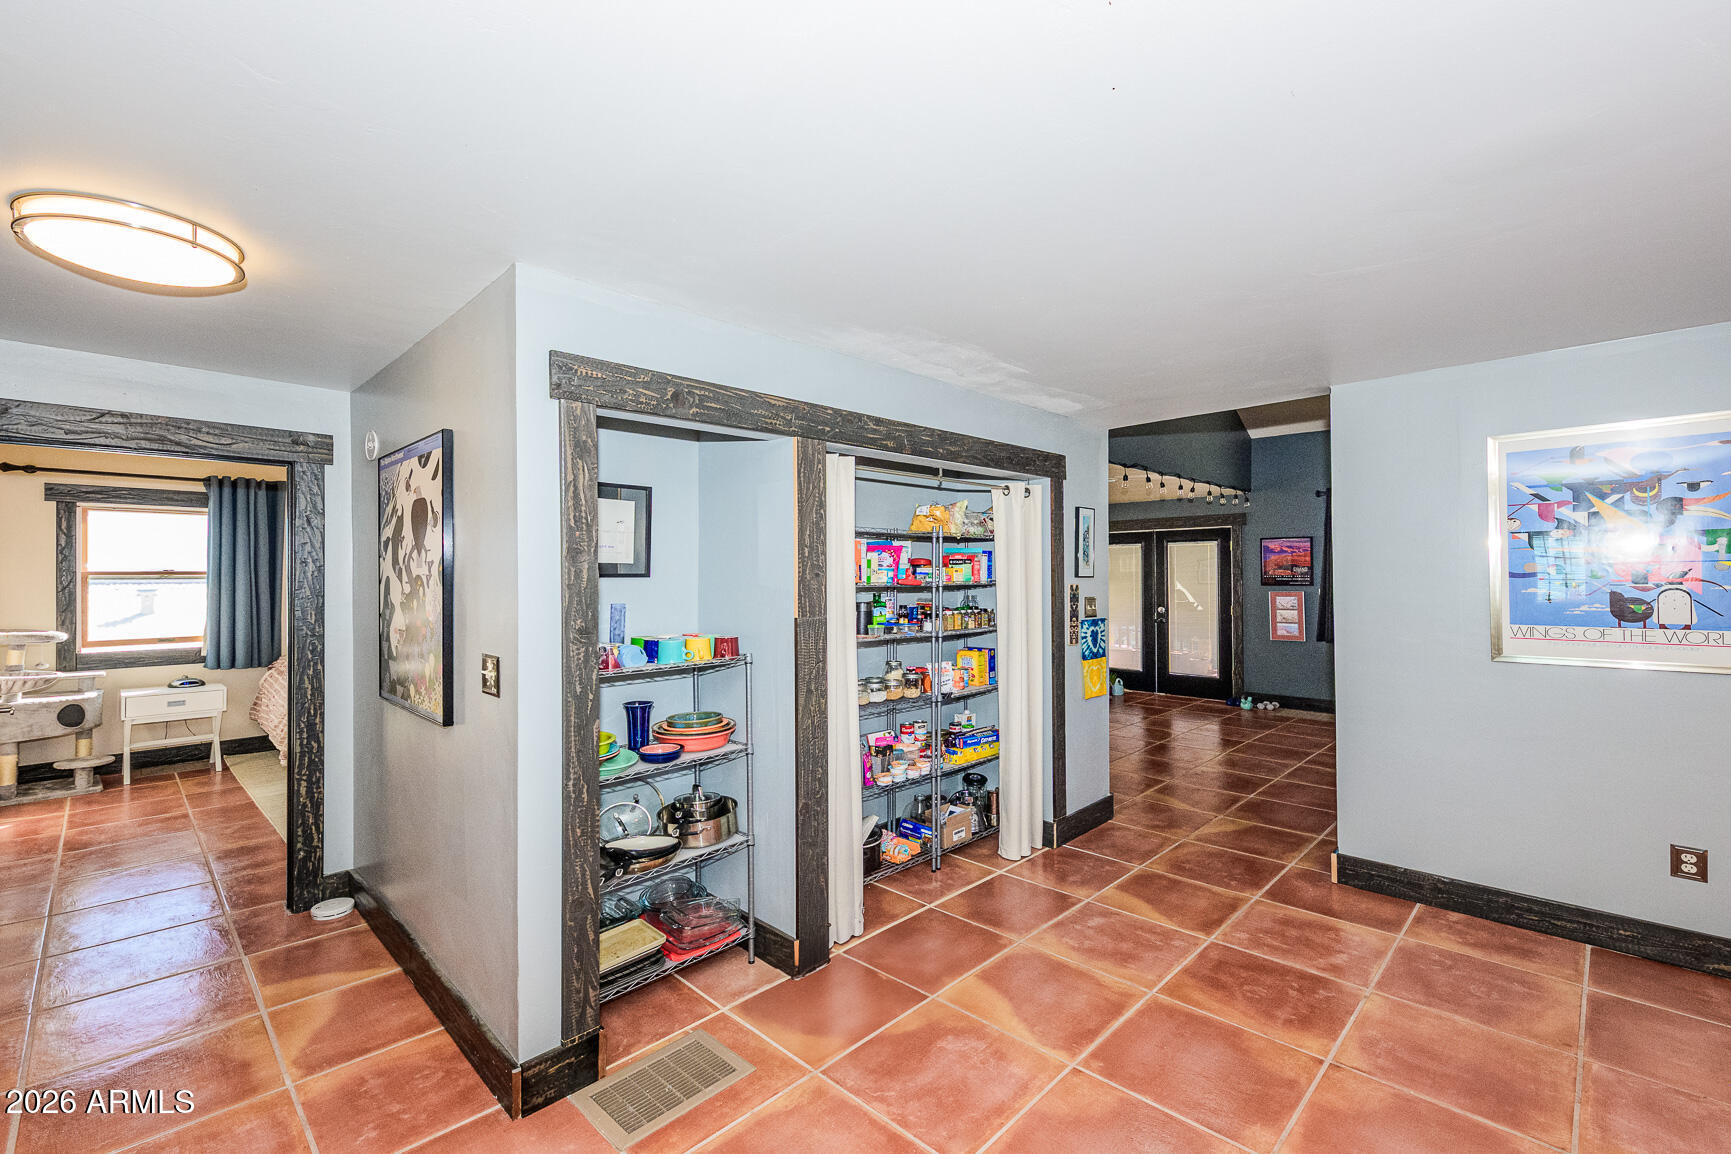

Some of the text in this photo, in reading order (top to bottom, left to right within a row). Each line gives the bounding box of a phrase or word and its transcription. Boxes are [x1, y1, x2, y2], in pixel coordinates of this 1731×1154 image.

[1510, 626, 1576, 640] WINGS
[1583, 628, 1613, 641] OF
[1619, 629, 1656, 642] THE
